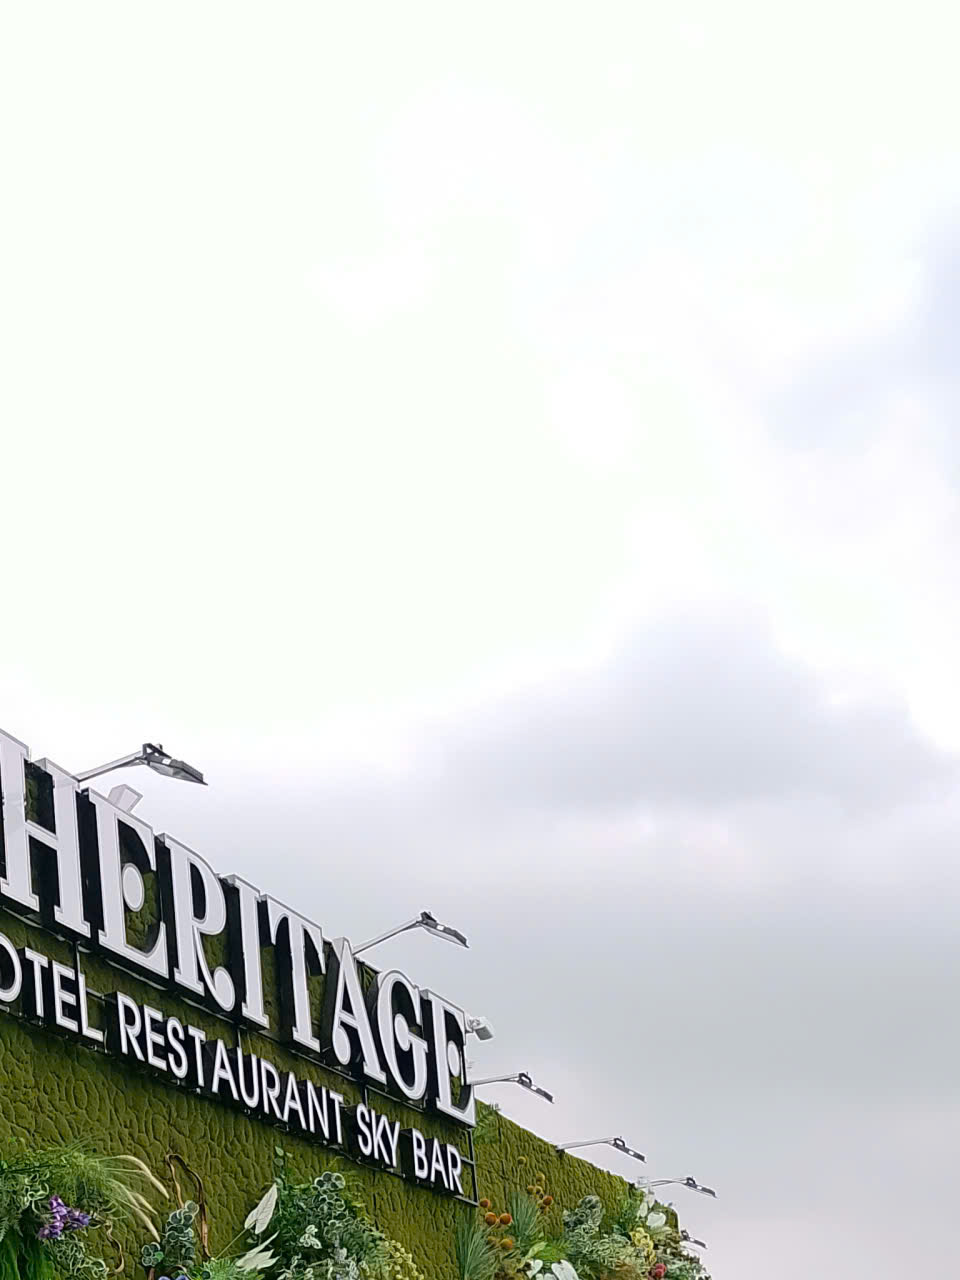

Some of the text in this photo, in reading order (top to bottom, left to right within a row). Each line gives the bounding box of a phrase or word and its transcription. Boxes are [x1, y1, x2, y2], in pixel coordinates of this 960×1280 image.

[115, 992, 343, 1144] RESTAURANT
[356, 1102, 401, 1169] SKY
[411, 1129, 464, 1195] BAR
